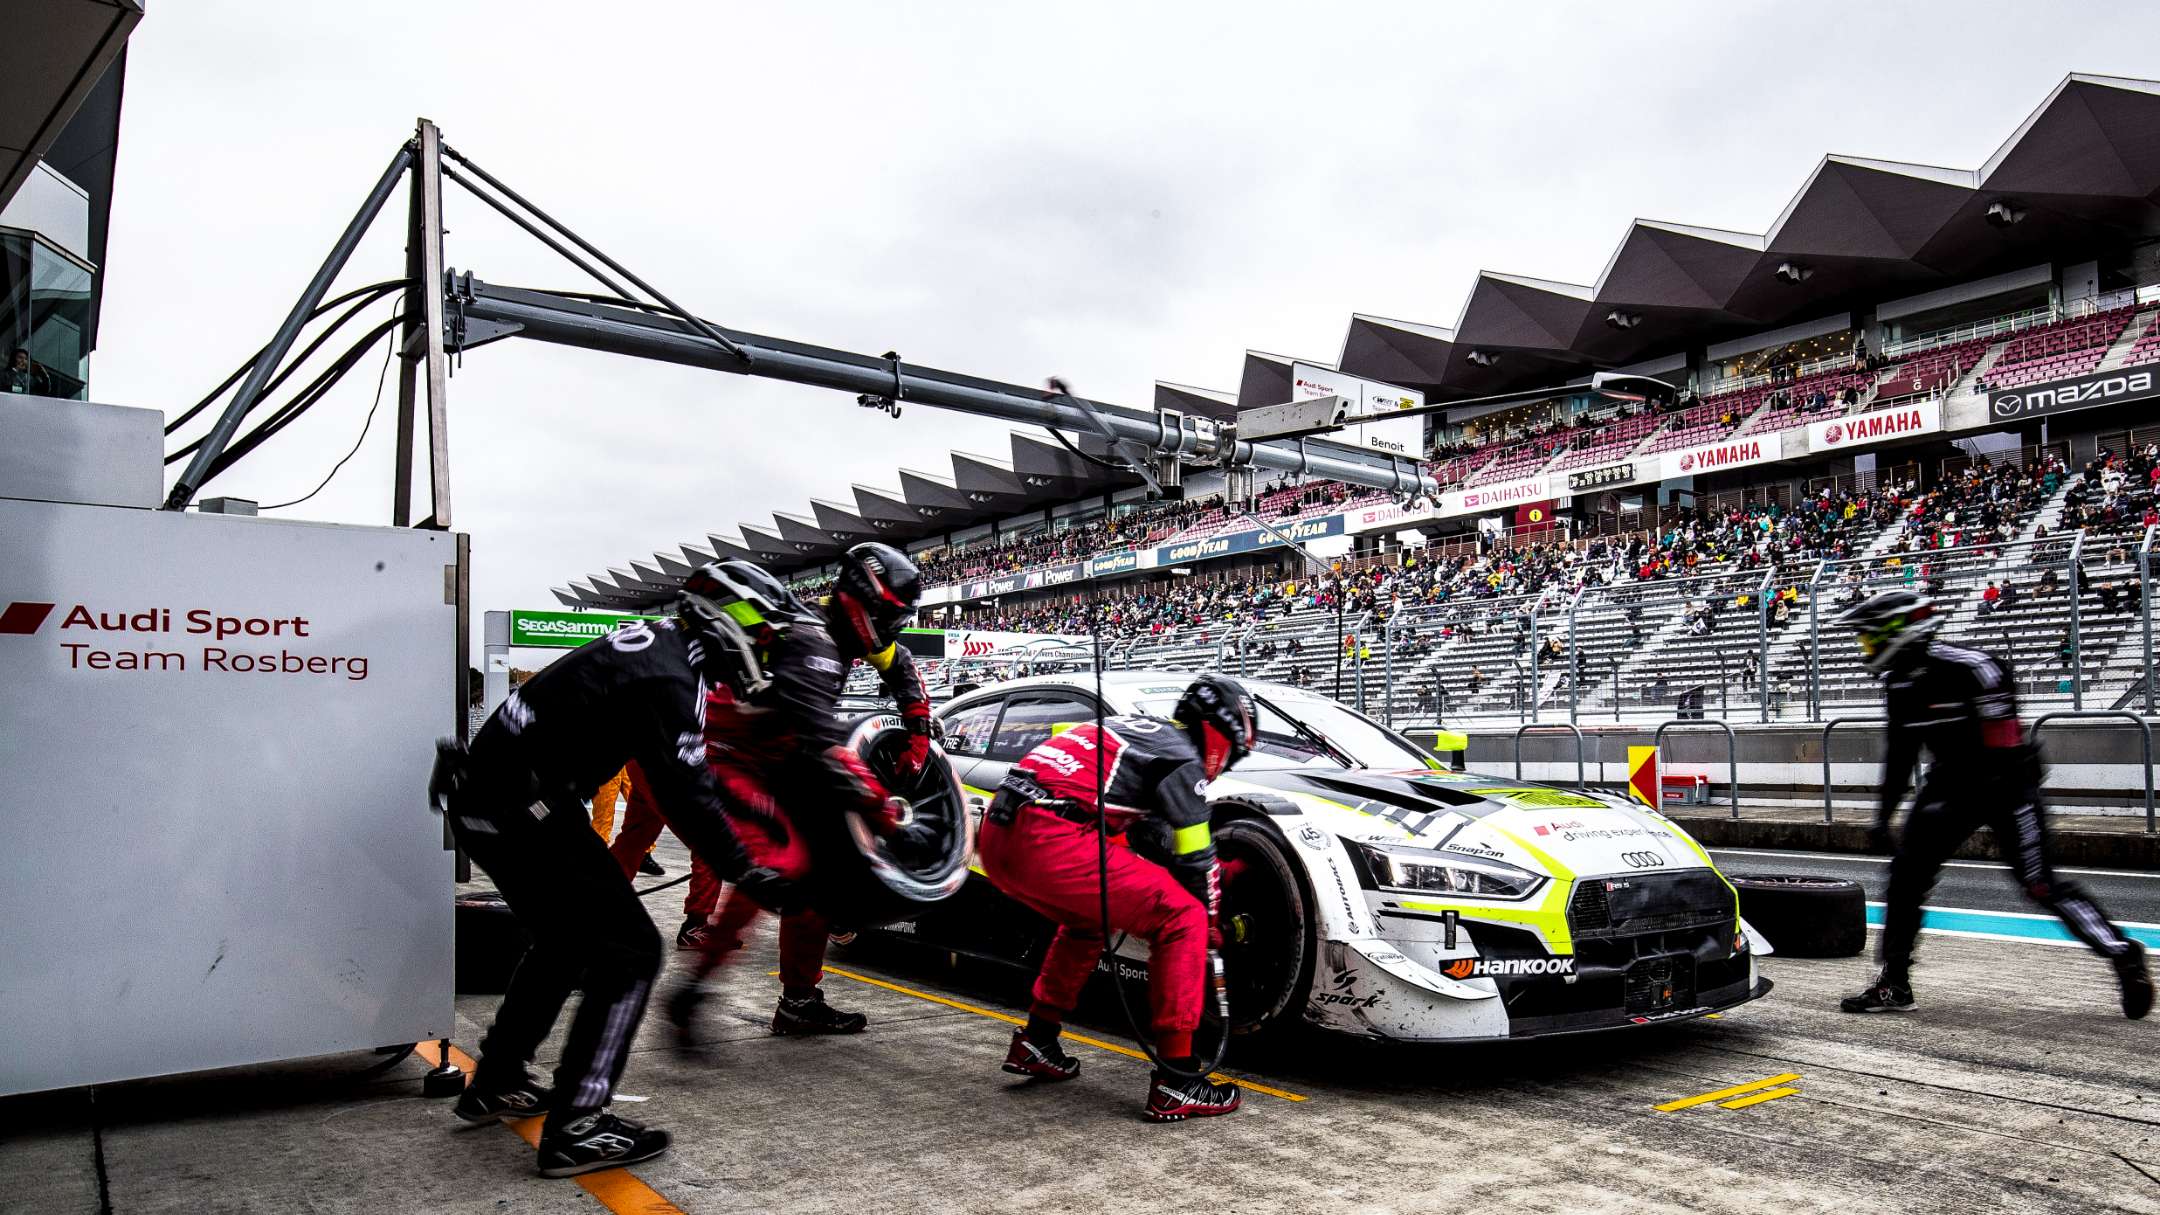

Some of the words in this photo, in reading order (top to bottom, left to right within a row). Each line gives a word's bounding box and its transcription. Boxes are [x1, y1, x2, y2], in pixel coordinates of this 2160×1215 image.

[1845, 410, 1922, 441] YAMAHA
[1371, 436, 1405, 453] Benoit
[1697, 441, 1761, 469] YAMAHA
[1482, 482, 1542, 505] DAIHATSU
[1170, 539, 1229, 560] GOODYEAR
[1045, 569, 1074, 585] Power
[989, 579, 1015, 594] Power
[61, 604, 170, 633] Audi
[186, 609, 310, 641] Sport
[517, 618, 615, 635] SEGASammy
[60, 643, 185, 671] Team
[203, 647, 369, 680] Rosberg
[1300, 827, 1321, 841] 45
[1563, 829, 1612, 842] driving
[1446, 843, 1505, 858] Snap-on
[1119, 964, 1149, 981] Sport
